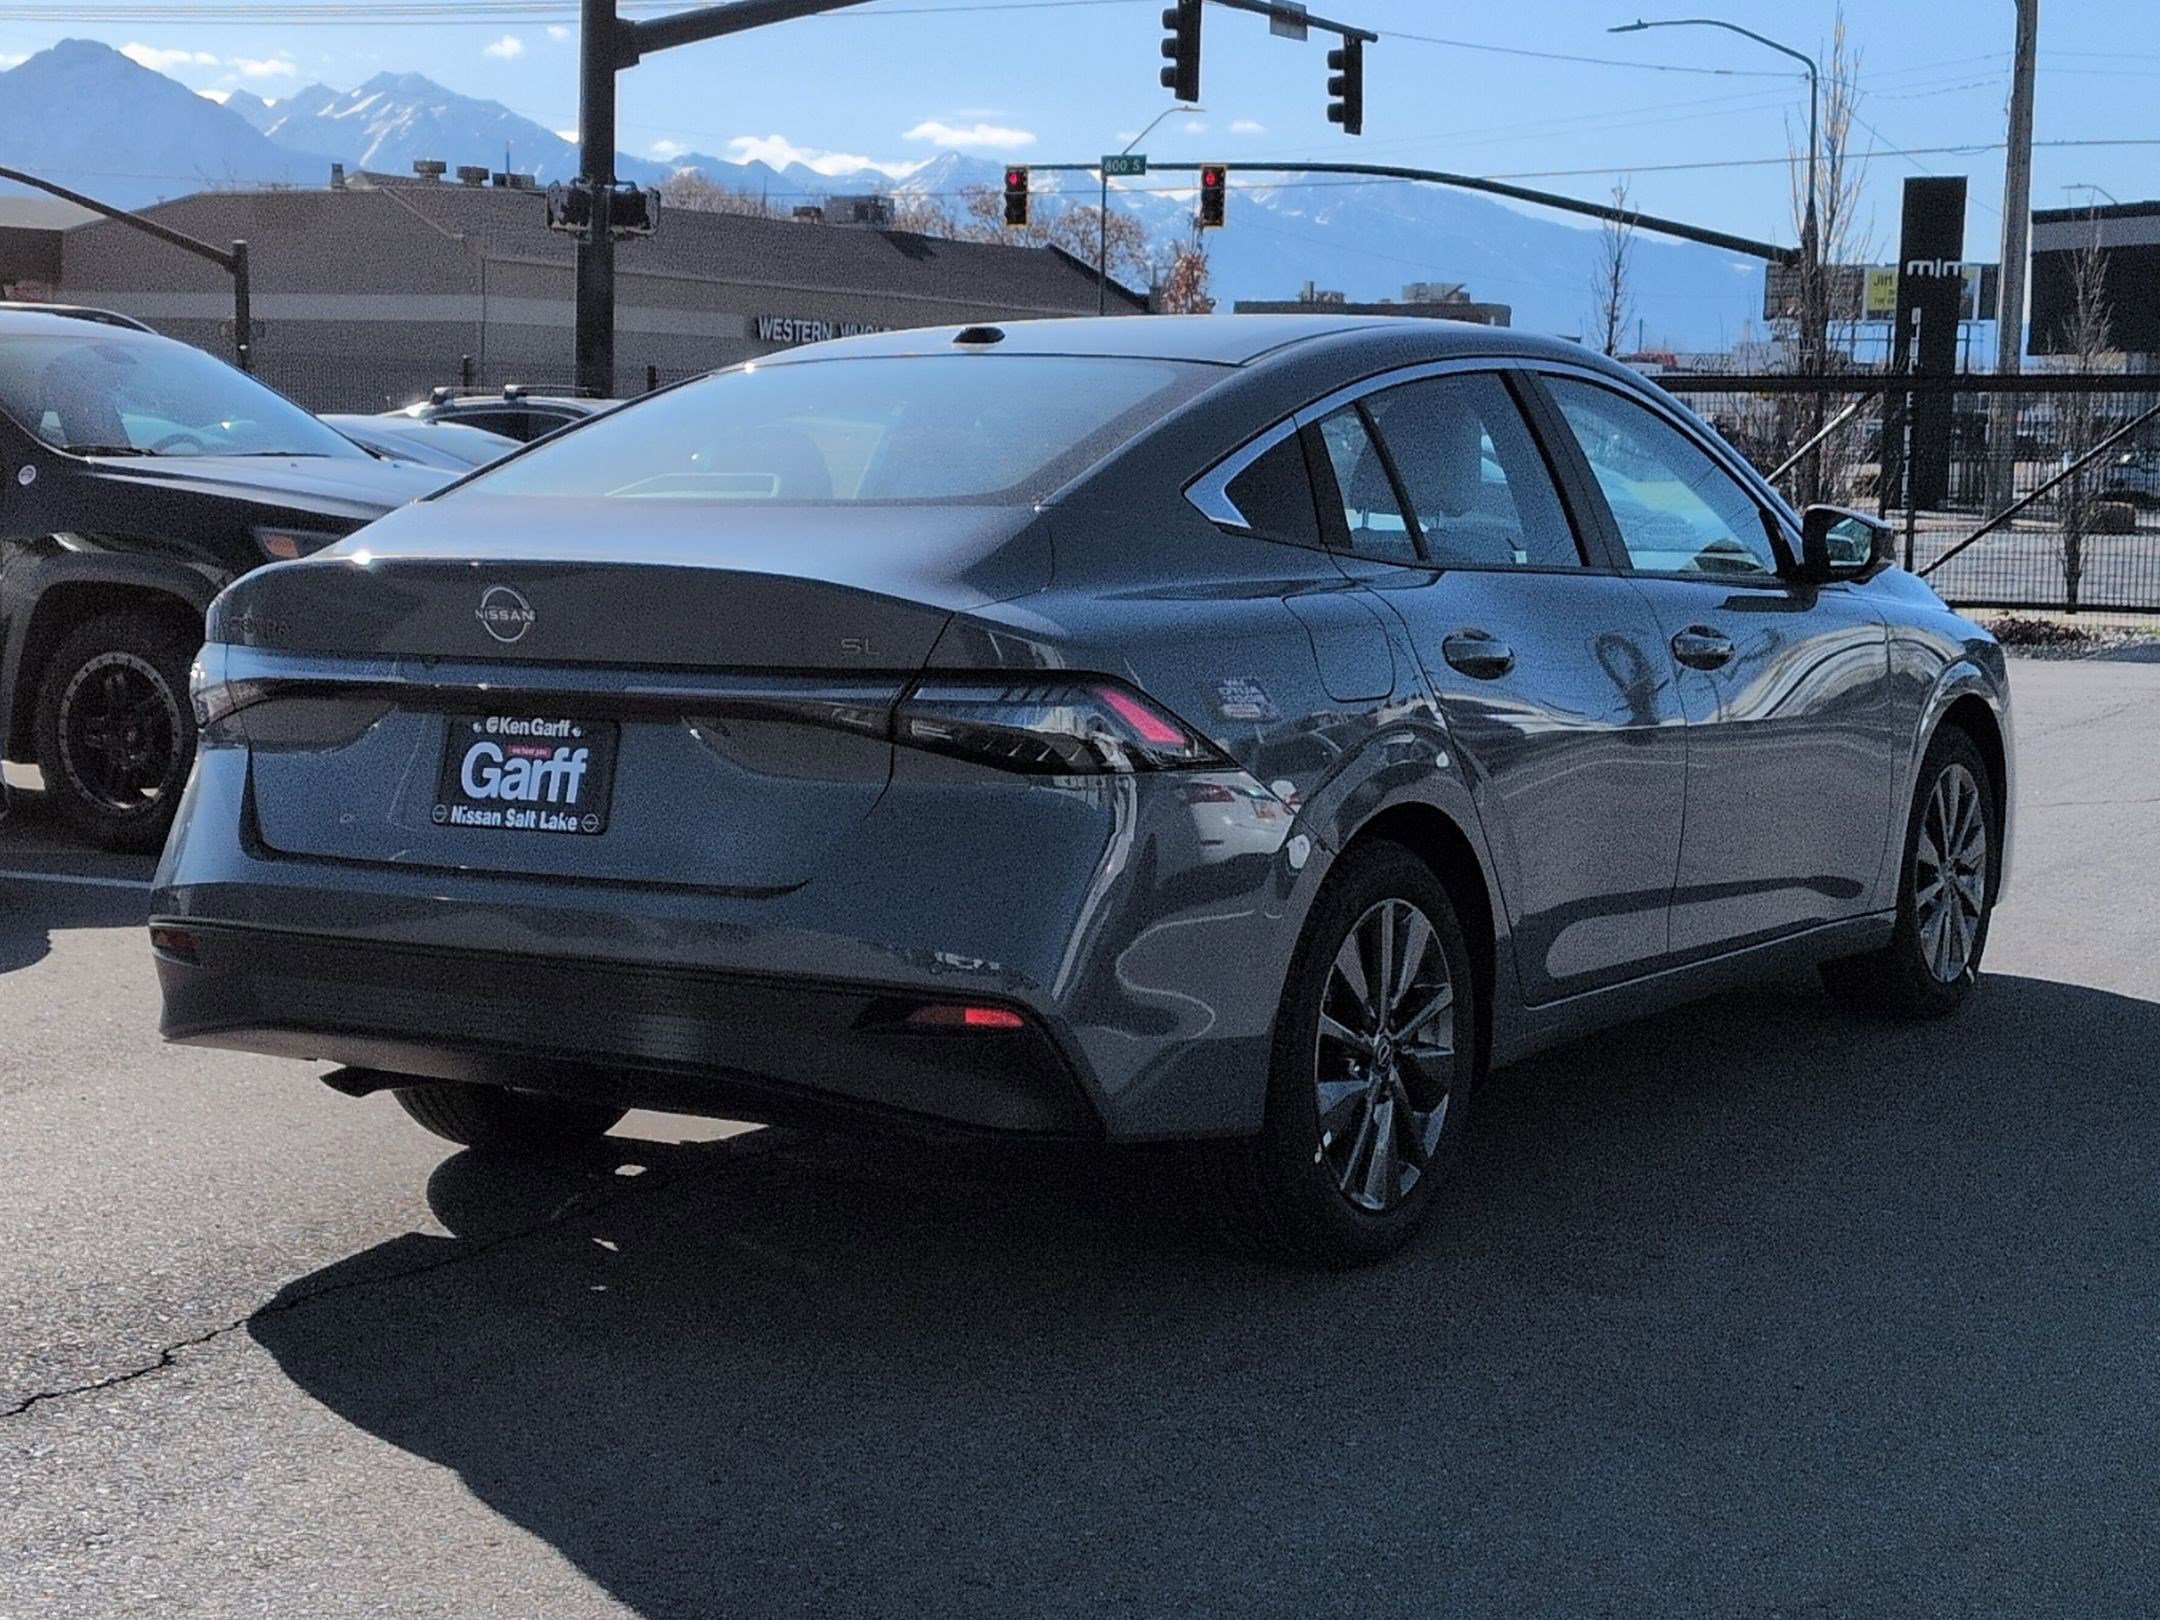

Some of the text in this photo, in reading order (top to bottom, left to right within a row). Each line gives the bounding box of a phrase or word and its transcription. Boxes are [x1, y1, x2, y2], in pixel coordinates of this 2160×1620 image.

[758, 316, 833, 342] WESTERN
[474, 608, 536, 622] NISSAN
[840, 637, 881, 656] SL
[460, 740, 589, 804] Garff
[450, 804, 578, 832] Nissan Salt Lake
